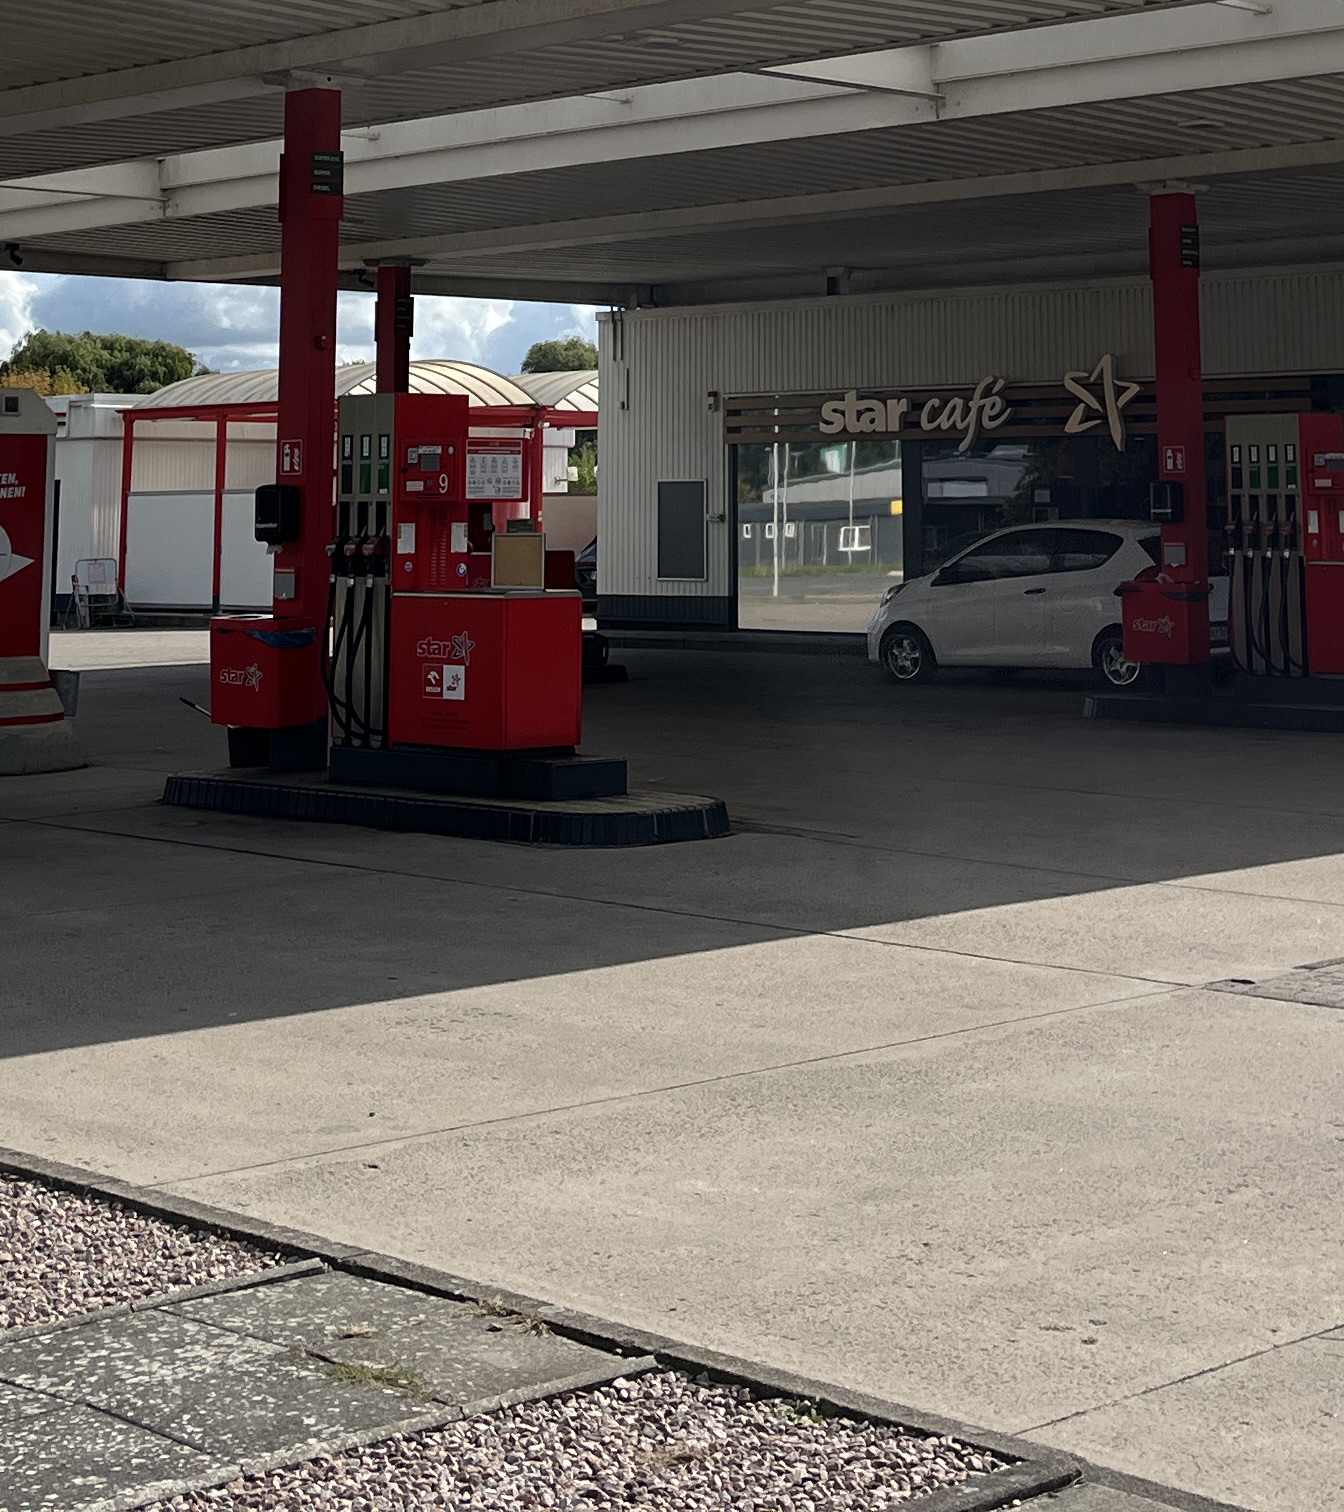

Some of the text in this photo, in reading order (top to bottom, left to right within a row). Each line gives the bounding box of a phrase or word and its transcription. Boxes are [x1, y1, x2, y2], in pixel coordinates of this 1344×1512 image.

[819, 375, 1013, 453] star café
[438, 473, 448, 493] 9
[1132, 617, 1156, 632] star
[417, 635, 451, 658] star
[219, 666, 245, 685] star
